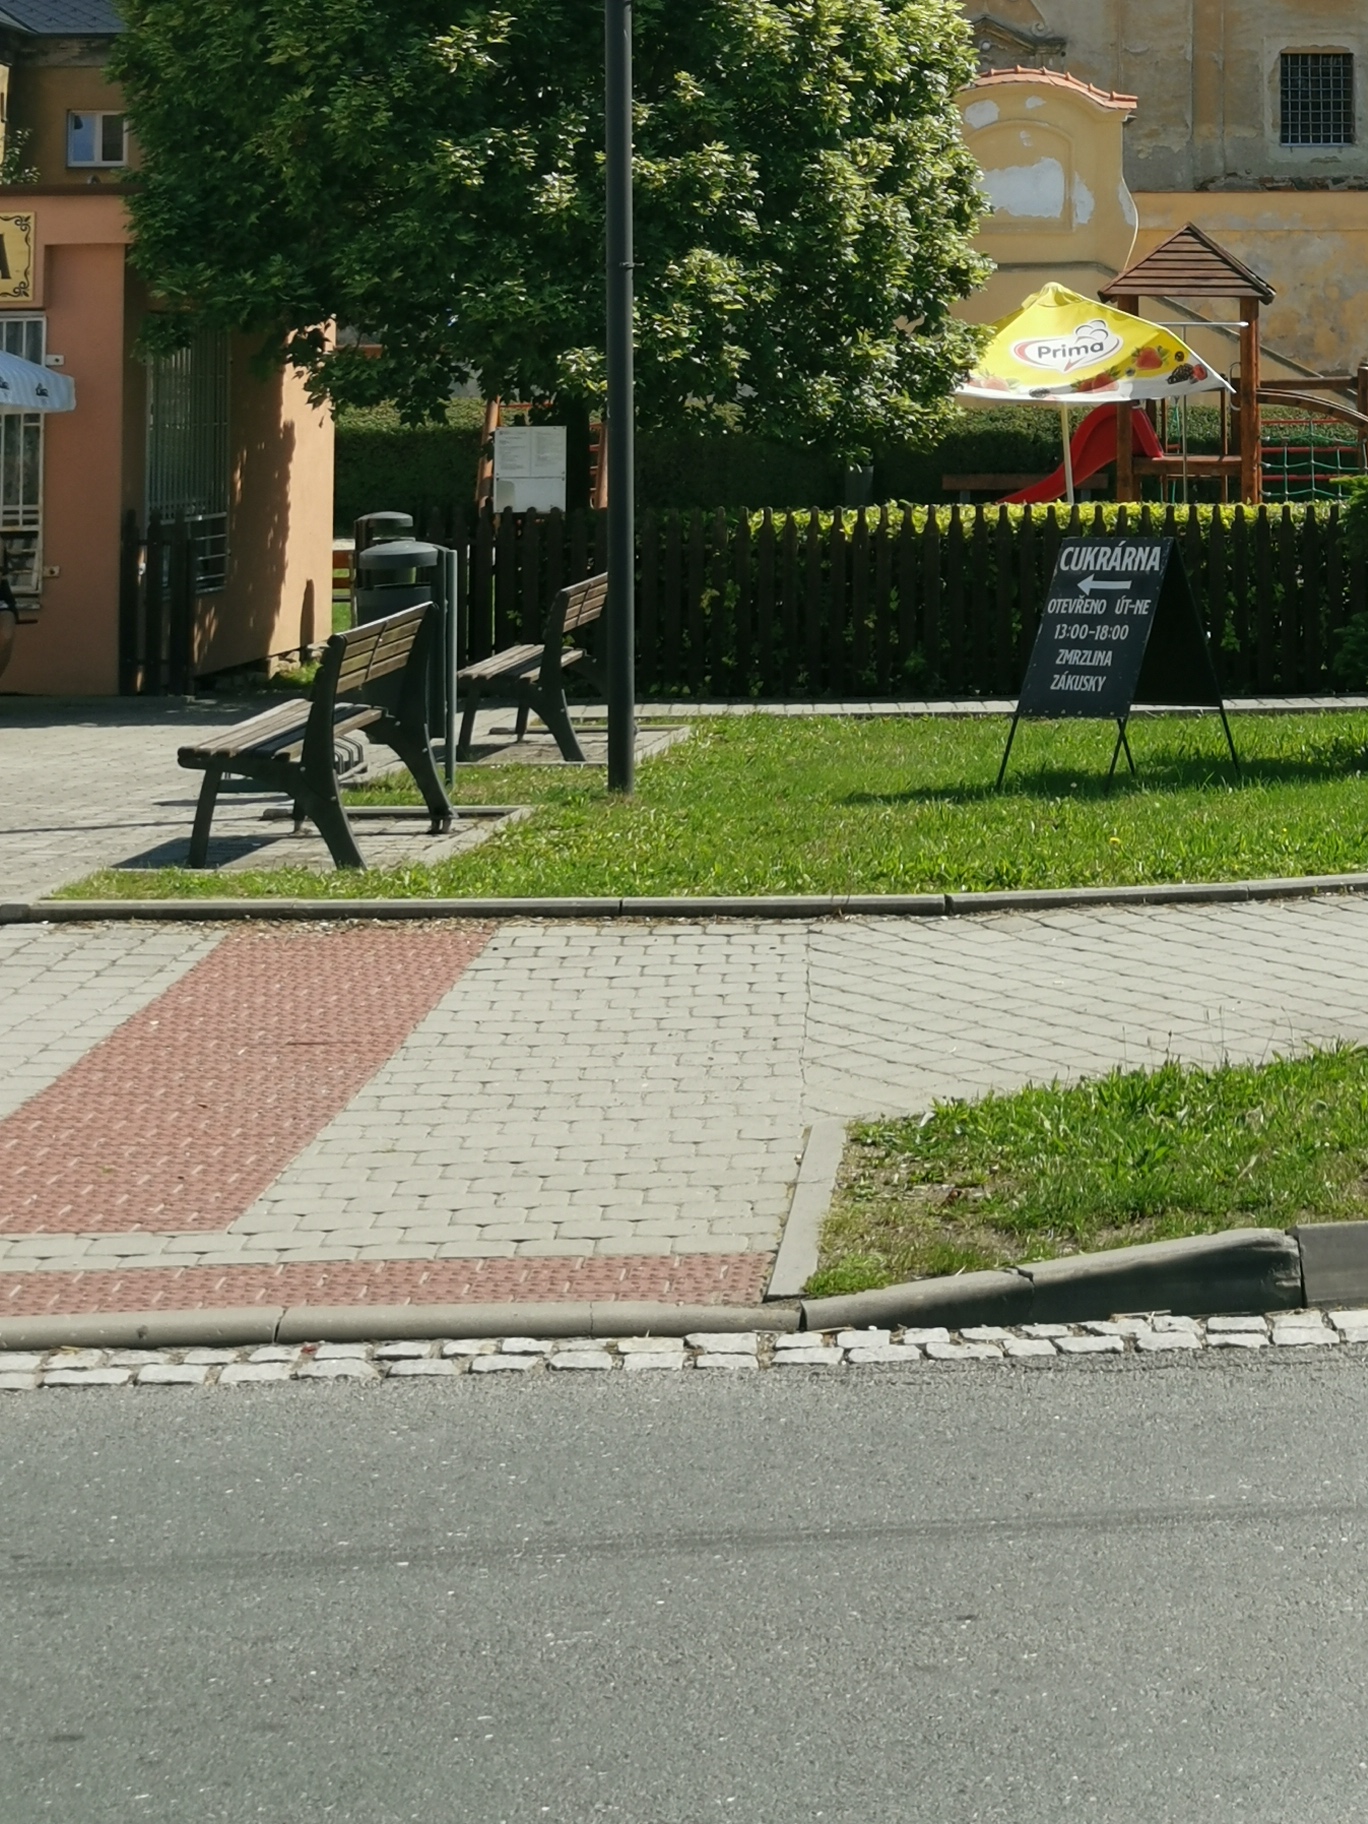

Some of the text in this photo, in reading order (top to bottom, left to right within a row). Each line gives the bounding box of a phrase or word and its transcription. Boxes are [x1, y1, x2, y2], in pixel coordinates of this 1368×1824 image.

[1038, 342, 1104, 359] Prima
[1060, 540, 1161, 571] CUKRÁRNA
[1047, 595, 1152, 615] OTEVŘENO ÚT-NE
[1054, 623, 1130, 641] 13:00-18:00
[1055, 649, 1113, 667] ZMRZLINA
[1050, 670, 1107, 692] ZÁKUSKY
